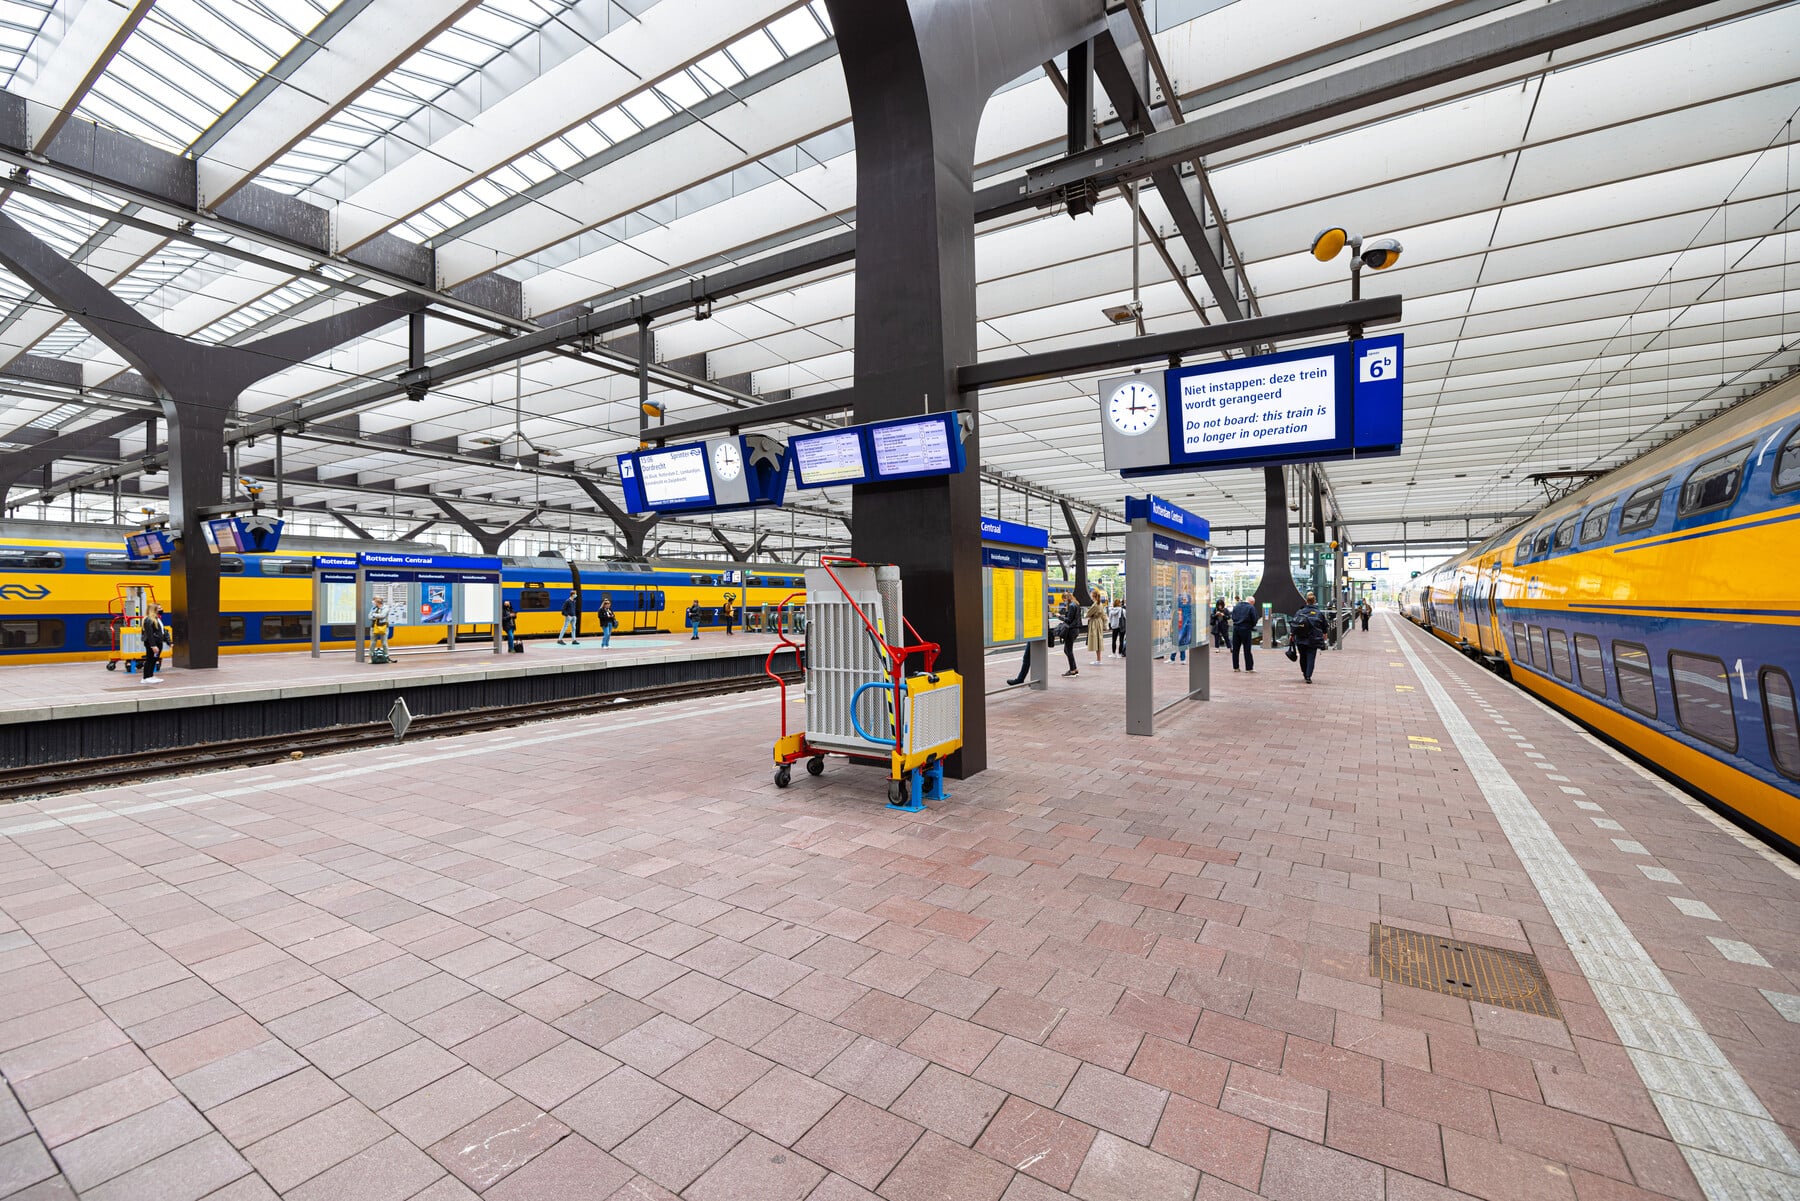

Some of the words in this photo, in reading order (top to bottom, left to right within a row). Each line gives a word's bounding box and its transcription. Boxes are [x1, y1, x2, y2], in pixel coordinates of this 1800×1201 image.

[1370, 357, 1391, 378] 6b
[1184, 385, 1206, 396] Niet
[1209, 378, 1265, 392] instappen:
[1269, 373, 1295, 384] deze
[1300, 368, 1327, 380] trein
[1185, 398, 1216, 410] wordt
[1220, 388, 1282, 408] gerangeerd
[1186, 421, 1200, 430] Do
[1203, 418, 1221, 428] not
[1224, 413, 1259, 426] board:
[1263, 410, 1283, 421] this
[1287, 407, 1313, 418] train
[1317, 405, 1326, 415] is
[1187, 436, 1199, 444] no
[1203, 432, 1236, 443] longer
[1240, 429, 1249, 438] in
[1253, 423, 1307, 439] operation
[642, 463, 666, 472] Dordrecht
[981, 522, 1001, 533] Centraal
[1734, 659, 1748, 700] 1
